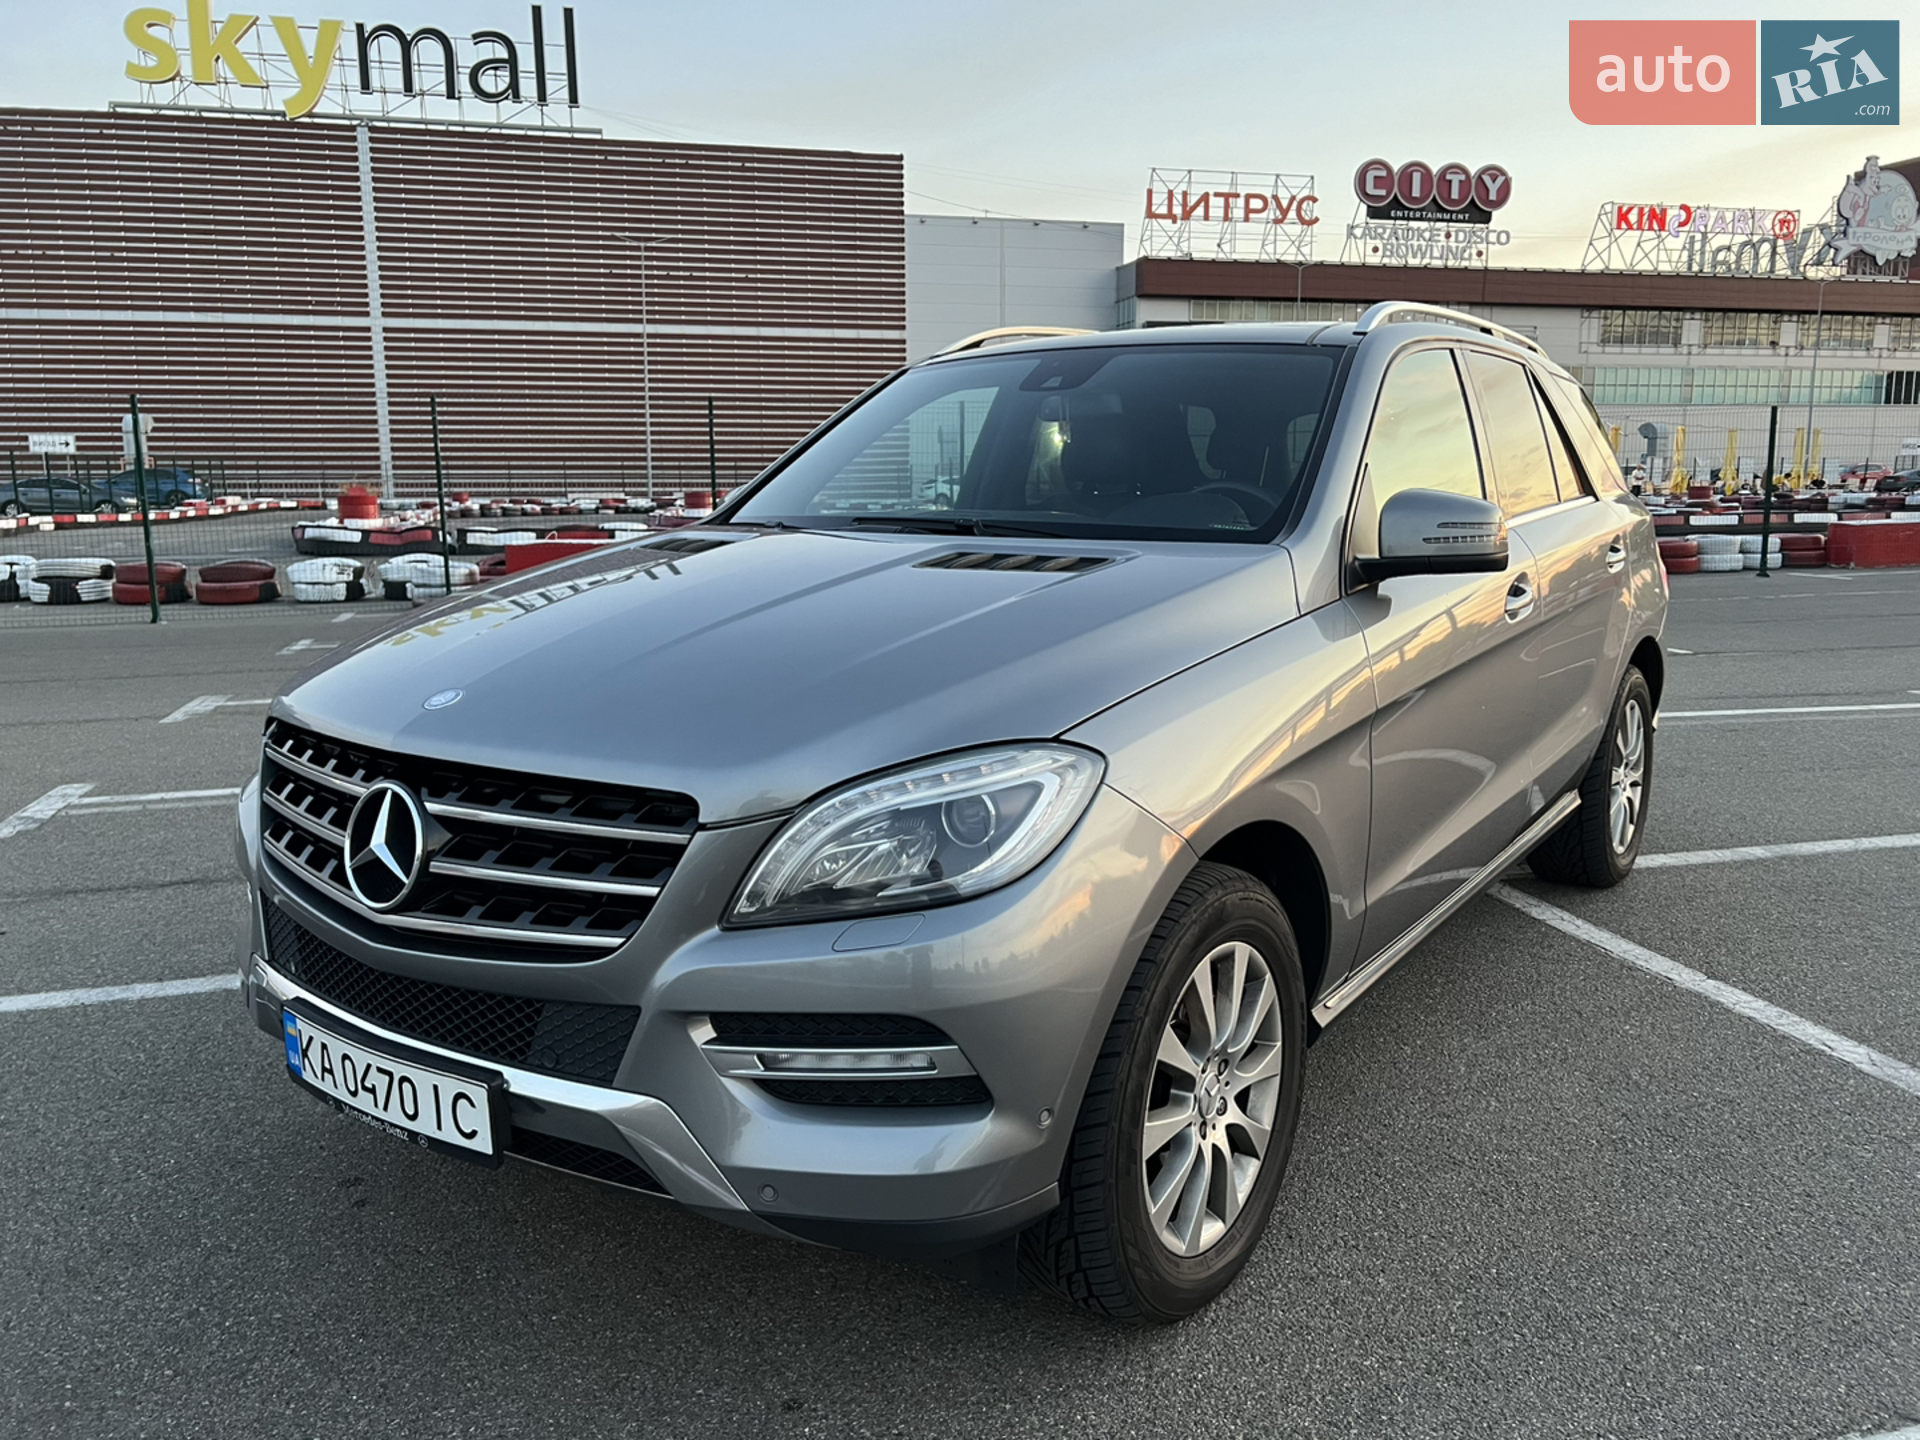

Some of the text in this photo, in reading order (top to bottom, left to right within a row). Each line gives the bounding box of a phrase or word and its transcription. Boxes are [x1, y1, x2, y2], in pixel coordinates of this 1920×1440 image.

[123, 0, 579, 120] skymall
[1363, 167, 1507, 202] CITY
[1146, 188, 1320, 226] ЦИТРУС
[1390, 209, 1470, 221] ENTERTAINMENT
[1346, 224, 1511, 246] KARAOKE DISCO
[1382, 242, 1473, 261] BOWLING
